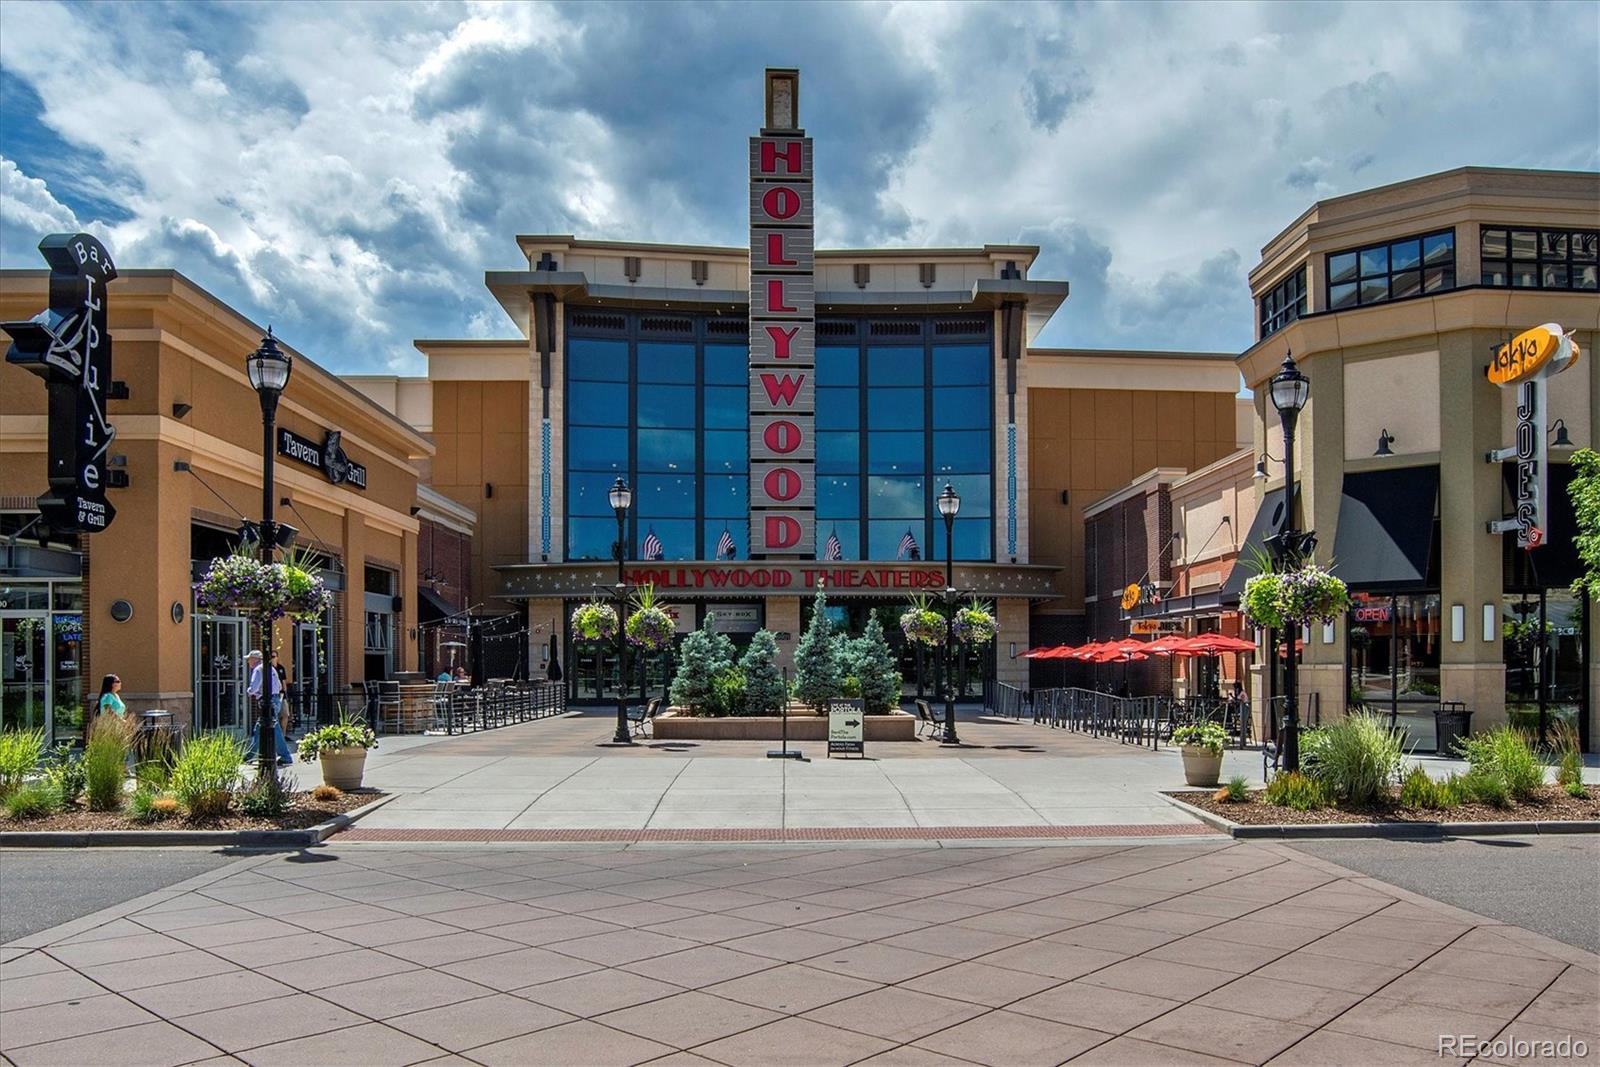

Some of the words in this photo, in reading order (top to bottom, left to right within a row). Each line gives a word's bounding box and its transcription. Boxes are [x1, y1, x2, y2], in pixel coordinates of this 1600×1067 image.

[75, 242, 112, 275] Bar
[760, 141, 805, 549] HOLLYWOOD
[1490, 333, 1538, 374] Tokyo
[283, 432, 320, 467] Tavern
[77, 496, 106, 513] Tavern
[77, 511, 86, 522] &
[87, 512, 105, 526] Grill
[623, 569, 792, 588] HOLLYWOOD
[800, 569, 946, 588] THEATERS
[1356, 608, 1388, 621] OPEN
